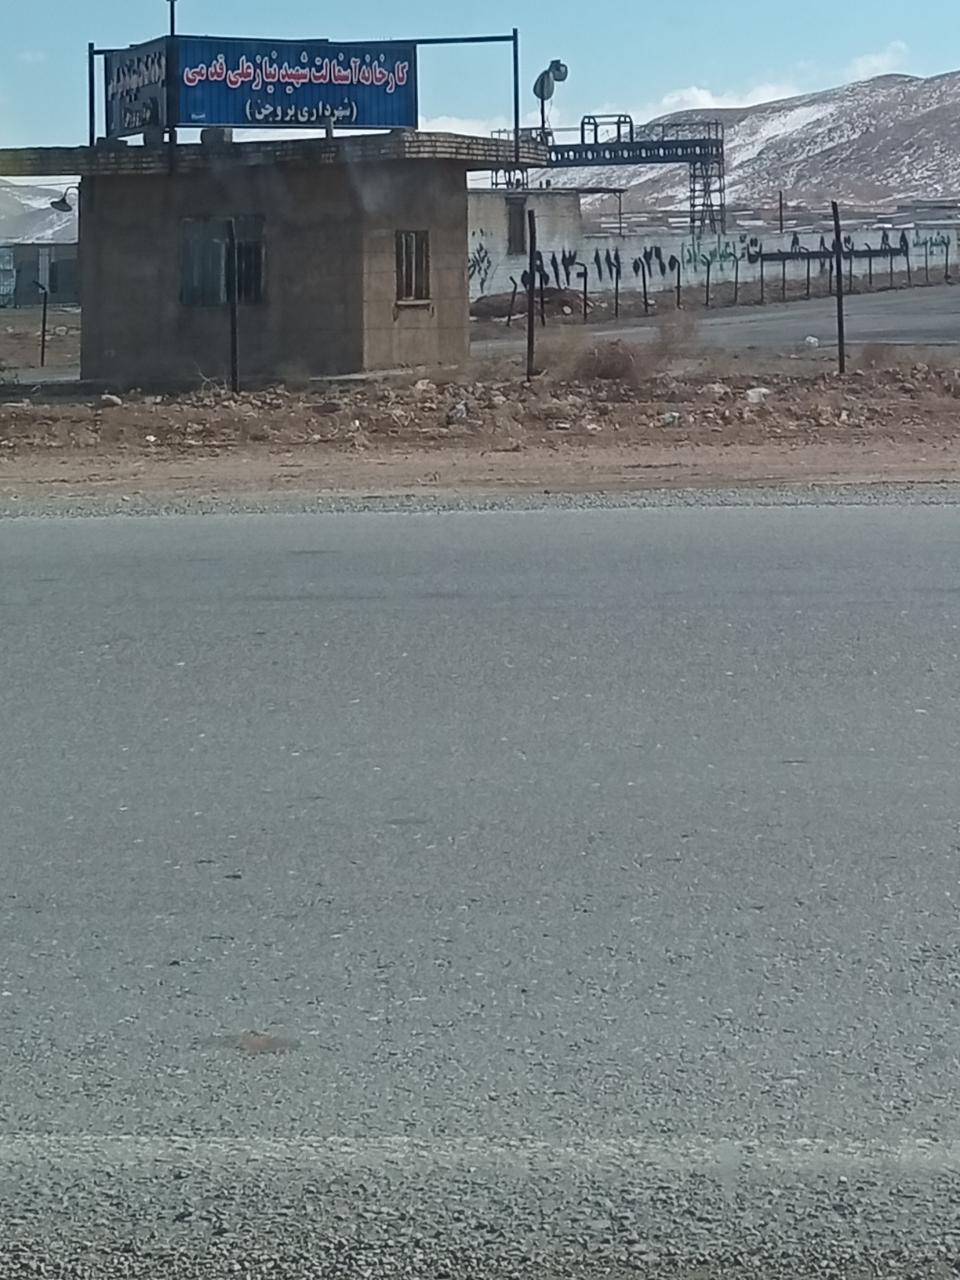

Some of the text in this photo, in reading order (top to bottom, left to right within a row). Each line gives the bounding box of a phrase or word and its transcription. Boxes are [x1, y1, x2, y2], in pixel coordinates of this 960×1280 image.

[183, 54, 227, 86] قدمی
[280, 51, 310, 94] شهید
[311, 52, 361, 84] آسفالت
[359, 53, 409, 93] کارخانه
